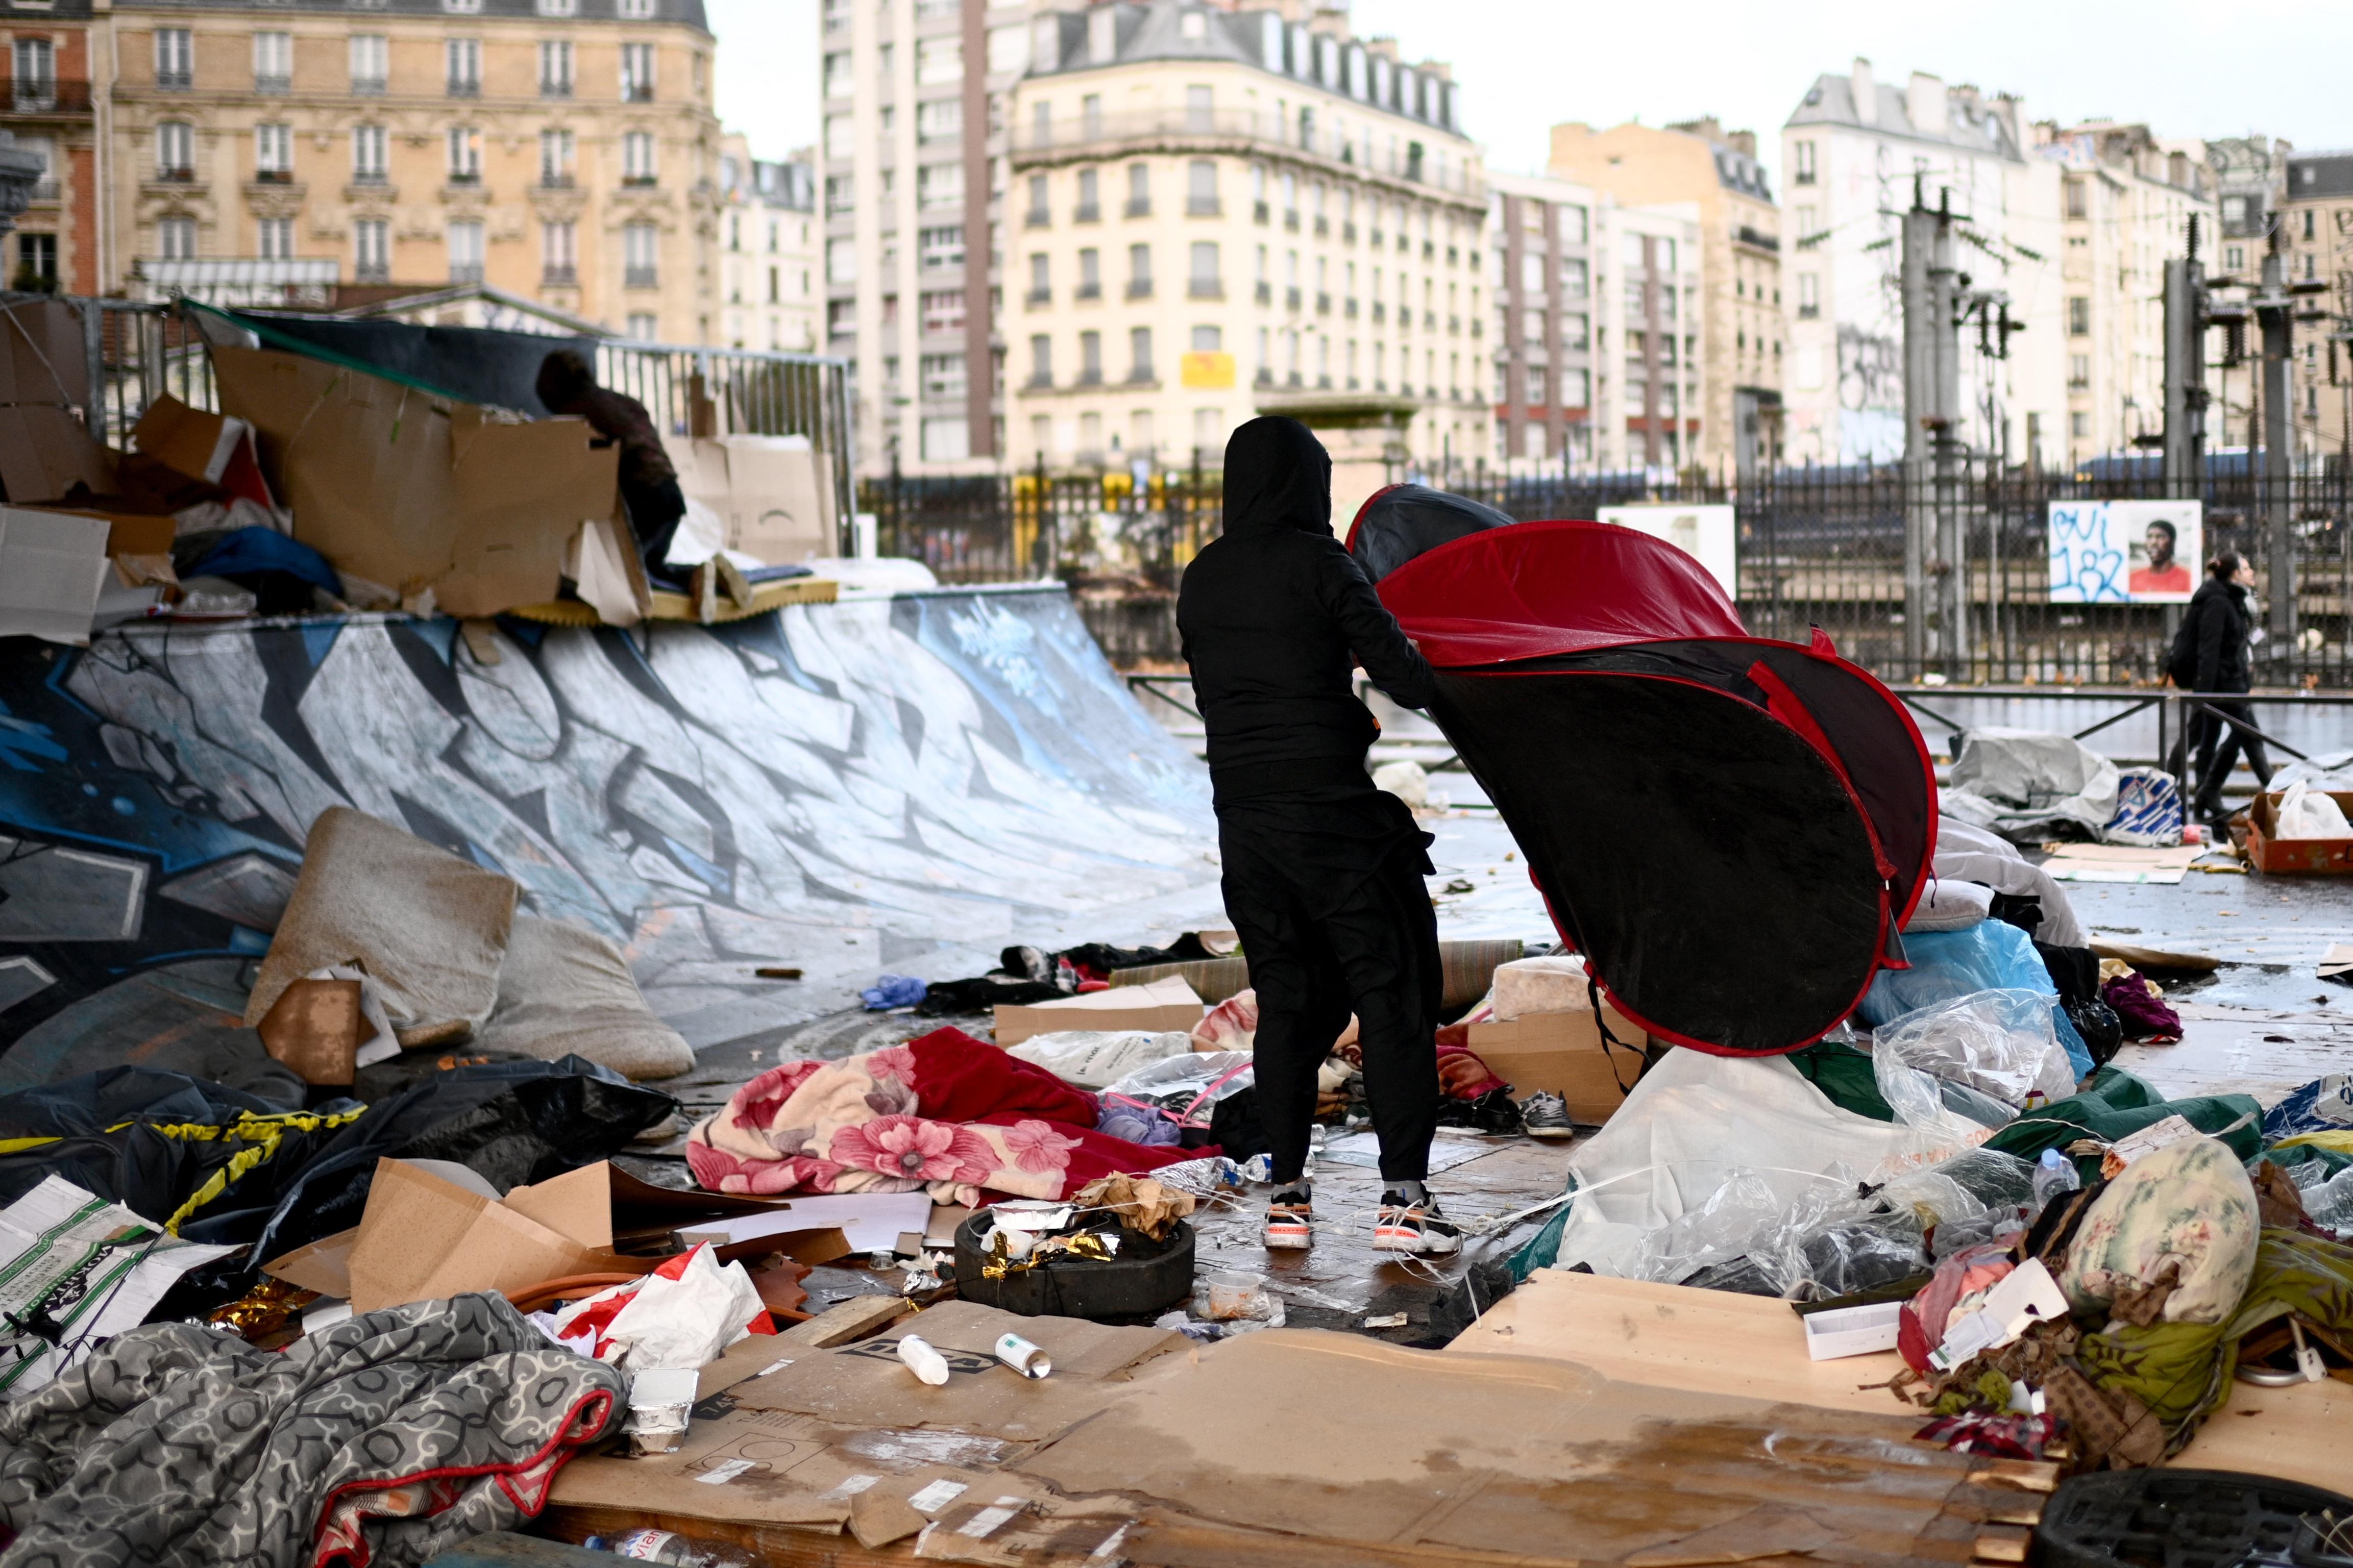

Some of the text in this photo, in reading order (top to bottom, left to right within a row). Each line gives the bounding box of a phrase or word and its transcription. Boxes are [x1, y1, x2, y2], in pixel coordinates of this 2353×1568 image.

[21, 1268, 77, 1314] LONDON
[864, 1344, 982, 1367] IA
[634, 1530, 665, 1559] vian
